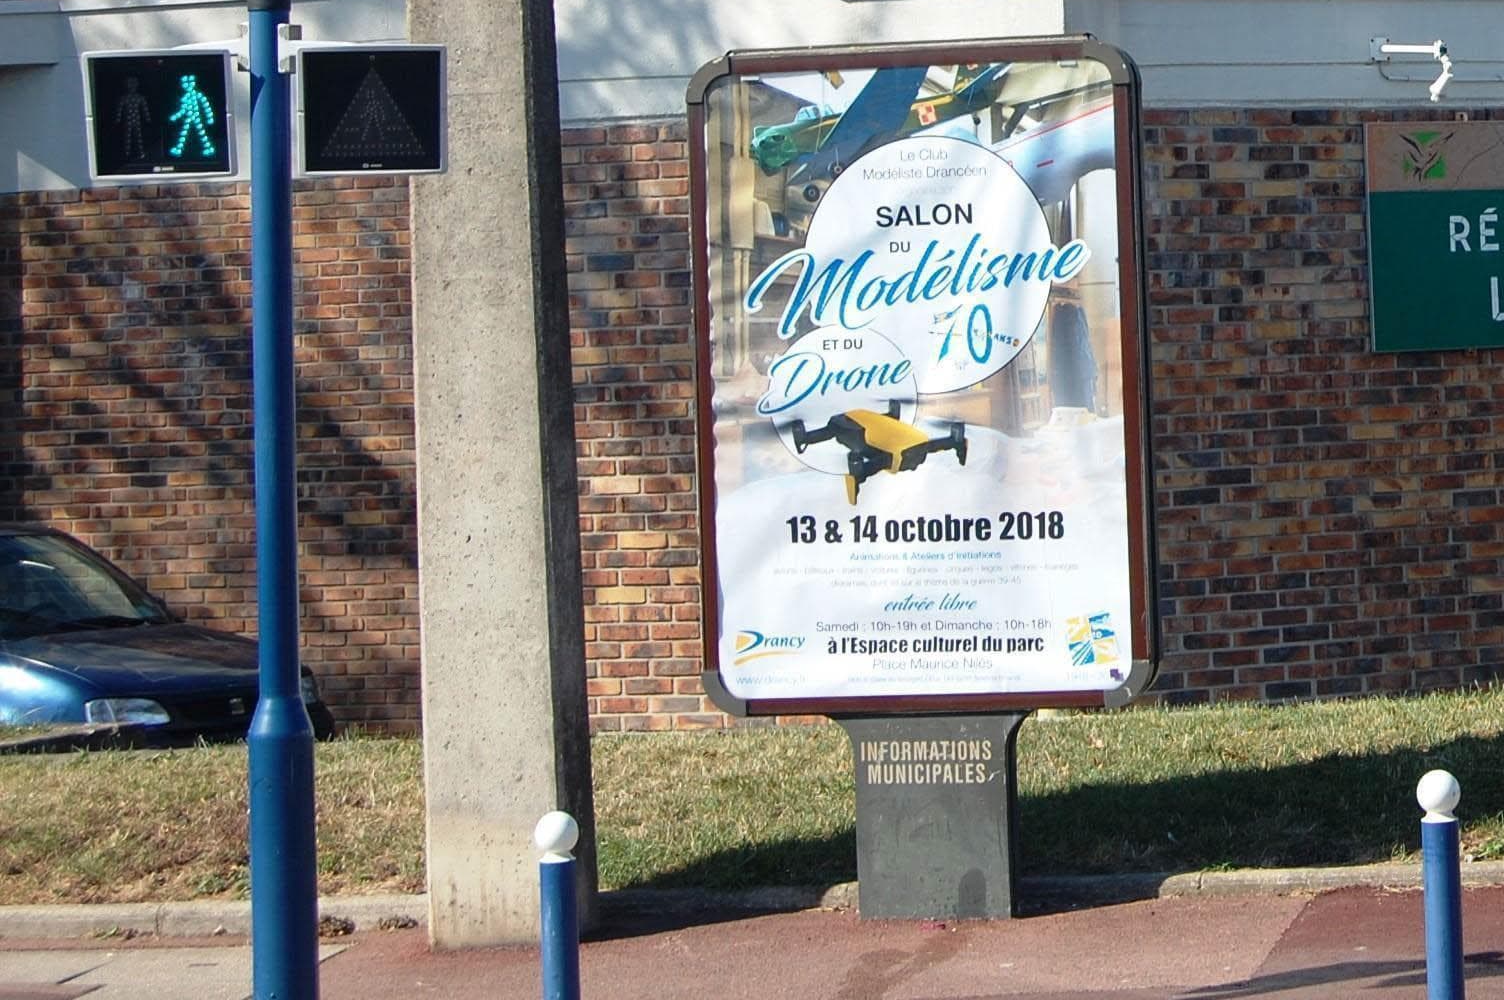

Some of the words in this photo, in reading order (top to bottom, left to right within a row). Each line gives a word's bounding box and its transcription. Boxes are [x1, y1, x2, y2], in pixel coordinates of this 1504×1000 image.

[900, 150, 915, 161] Le
[919, 148, 948, 161] Club
[876, 203, 973, 228] SALON
[889, 241, 911, 253] DU
[746, 233, 1087, 337] Modélisme
[822, 339, 840, 351] ET
[843, 338, 864, 350] DU
[757, 352, 913, 415] Drone
[786, 516, 818, 544] 13
[824, 518, 844, 544] &
[849, 515, 878, 543] 14
[885, 513, 992, 543] octobre
[998, 511, 1065, 541] 2018
[884, 593, 935, 611] entrée
[938, 592, 978, 611] libre
[816, 621, 859, 632] Samedi
[871, 620, 917, 632] 10h-19h
[920, 621, 931, 631] et
[935, 619, 993, 631] Dimanche
[1005, 618, 1052, 630] 10h-18h
[736, 630, 806, 655] Drancy
[827, 636, 838, 654] à
[841, 636, 909, 656] l'Espace
[912, 635, 978, 653] culturel
[981, 635, 1003, 652] du
[1006, 637, 1045, 654] parc
[872, 658, 907, 671] Place
[910, 658, 959, 670] Maurice
[860, 740, 992, 762] INFORMATIONS
[867, 763, 986, 784] MUNICIPALES
